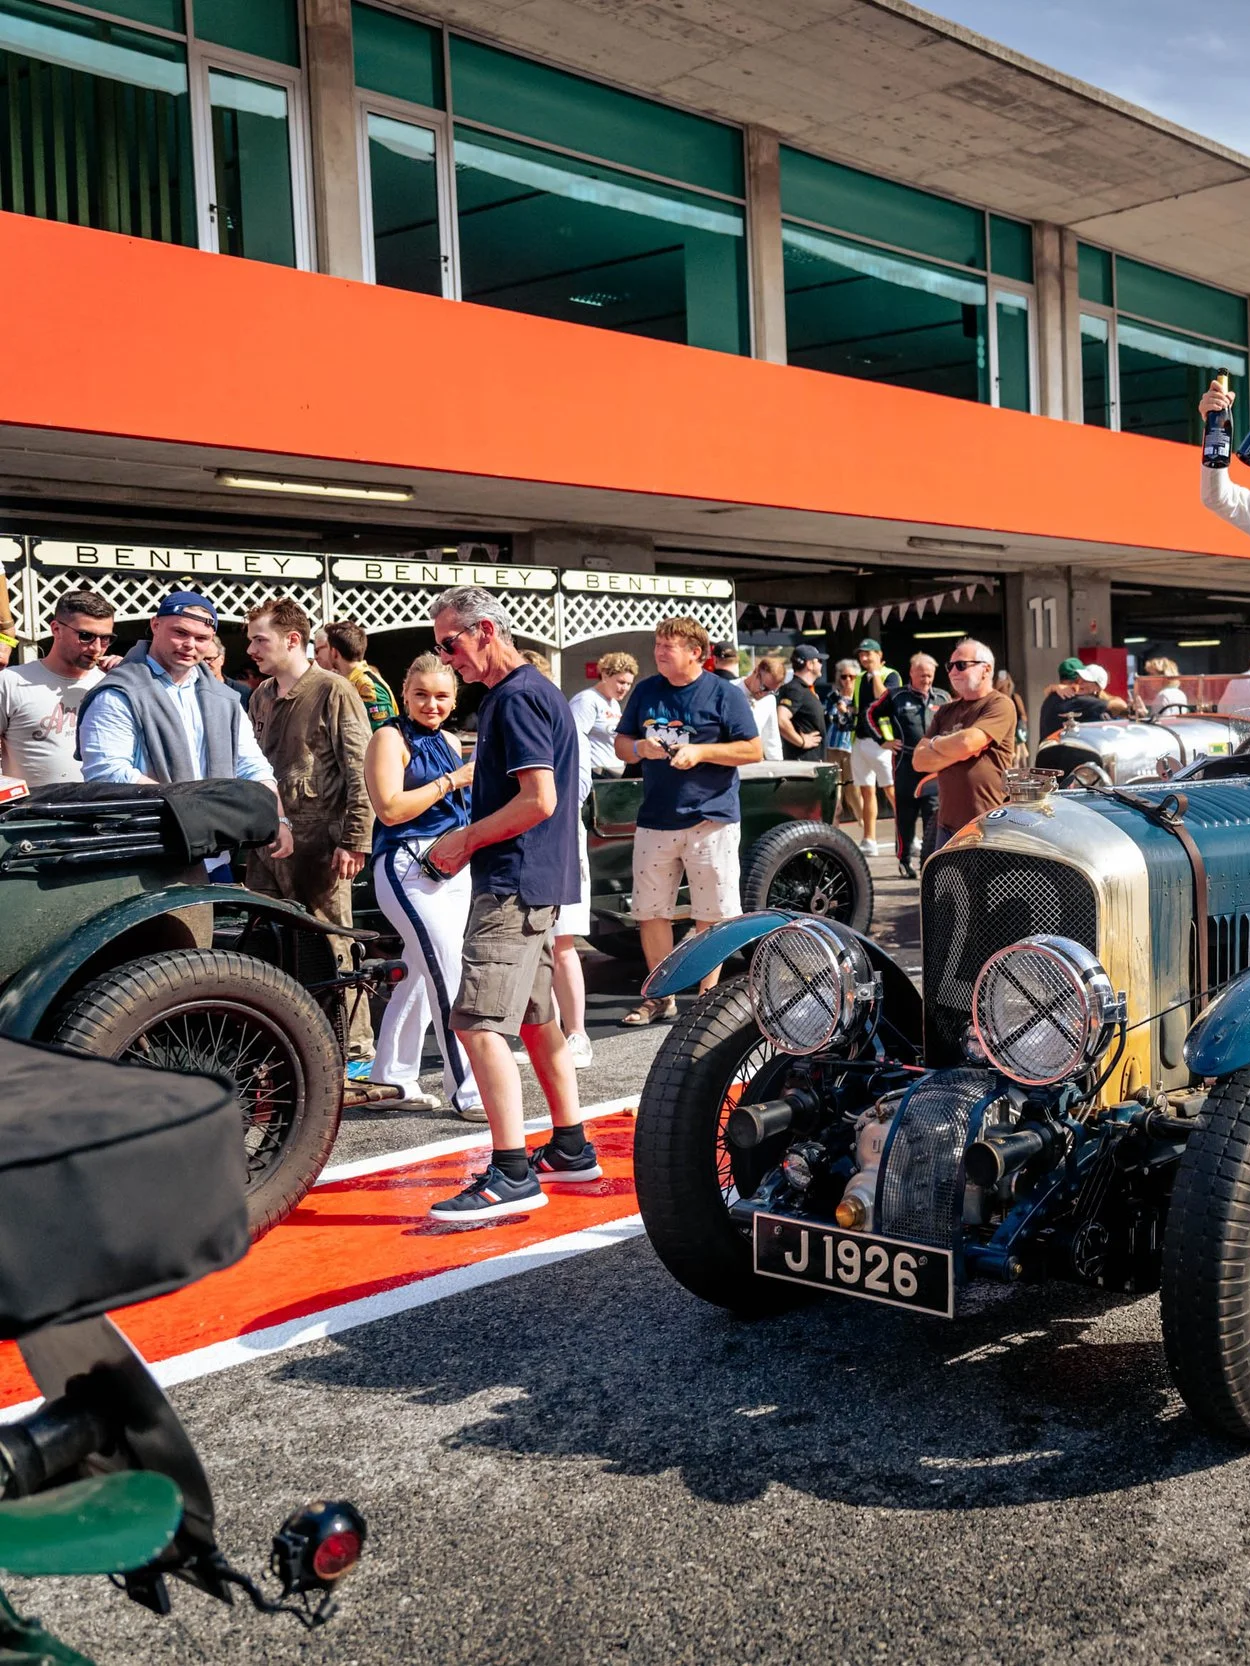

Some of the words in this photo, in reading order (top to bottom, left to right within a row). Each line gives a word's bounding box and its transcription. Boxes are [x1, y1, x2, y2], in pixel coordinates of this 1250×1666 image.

[76, 545, 291, 574] BENTLEY
[365, 562, 533, 586] BENTLEY
[586, 574, 714, 595] BENTLEY
[1028, 596, 1058, 649] 11
[987, 809, 1005, 819] B
[784, 1230, 809, 1272] J
[822, 1235, 918, 1297] 1926
